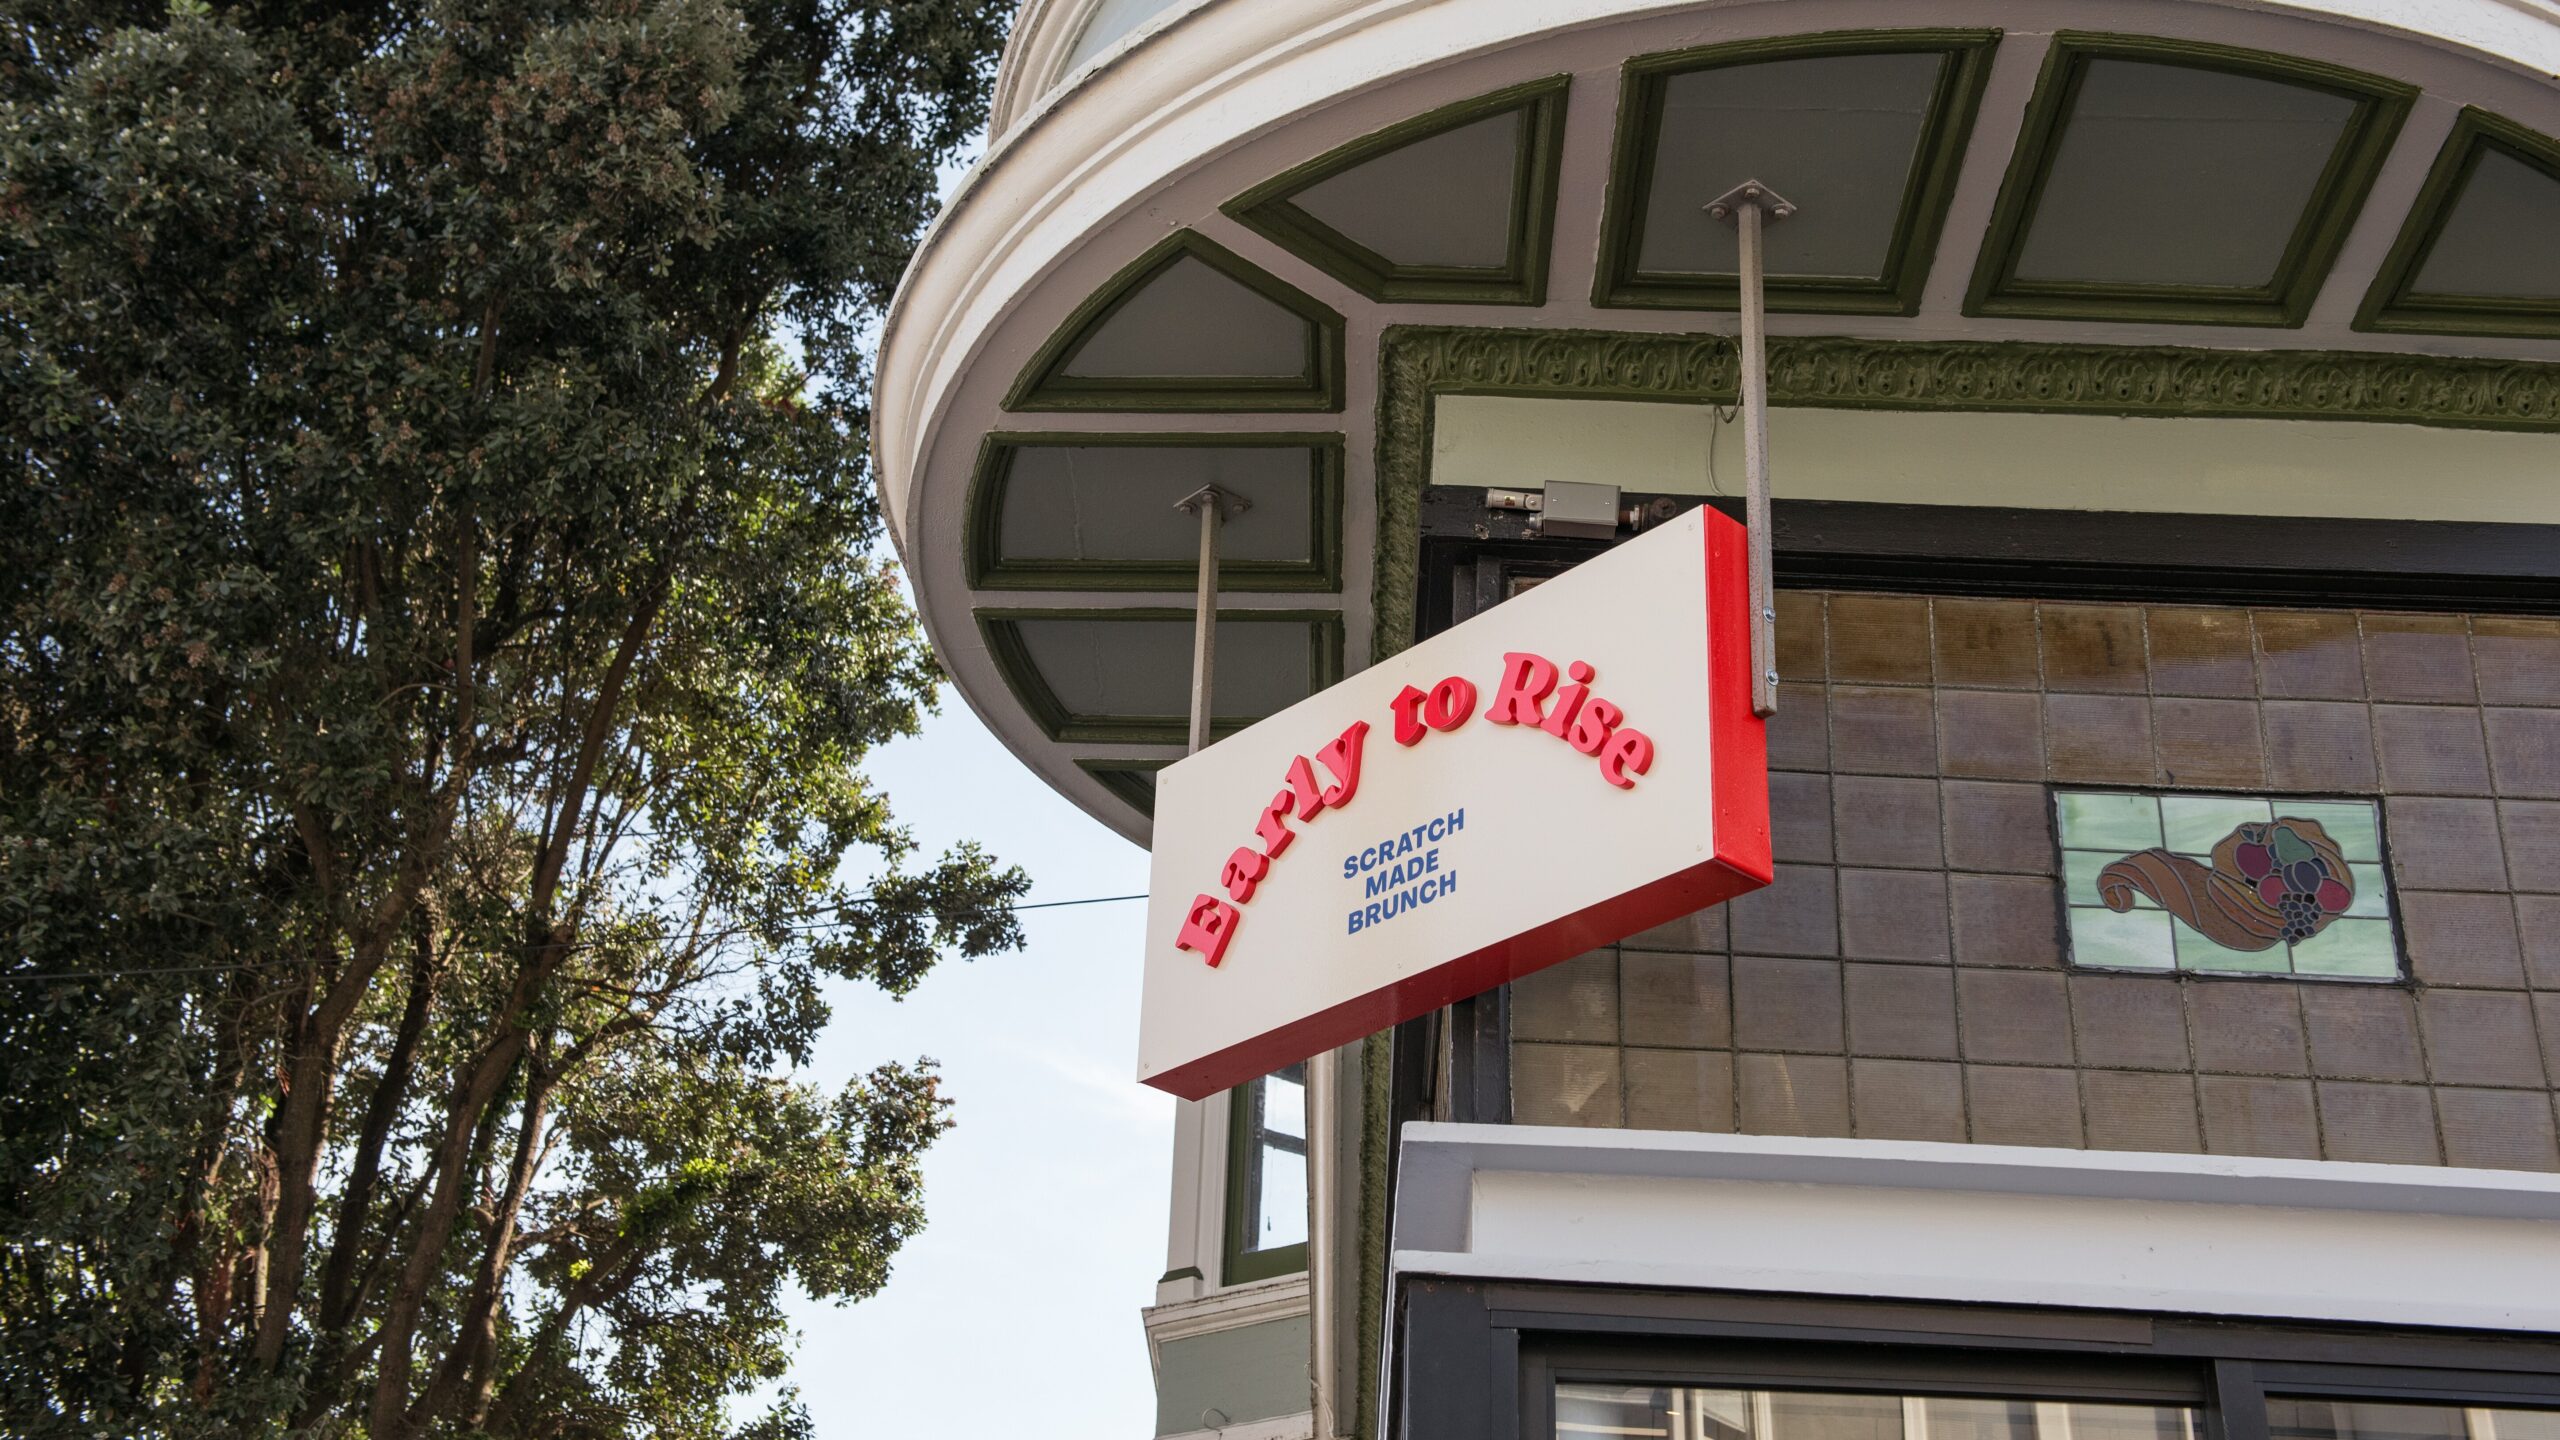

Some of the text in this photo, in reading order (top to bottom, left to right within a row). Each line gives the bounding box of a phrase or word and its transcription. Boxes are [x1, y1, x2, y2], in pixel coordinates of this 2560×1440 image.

[1174, 651, 1655, 969] Early to Rise
[1343, 808, 1465, 880] SCRATCH
[1347, 870, 1457, 935] BRUNCH
[1365, 849, 1439, 899] MADE
